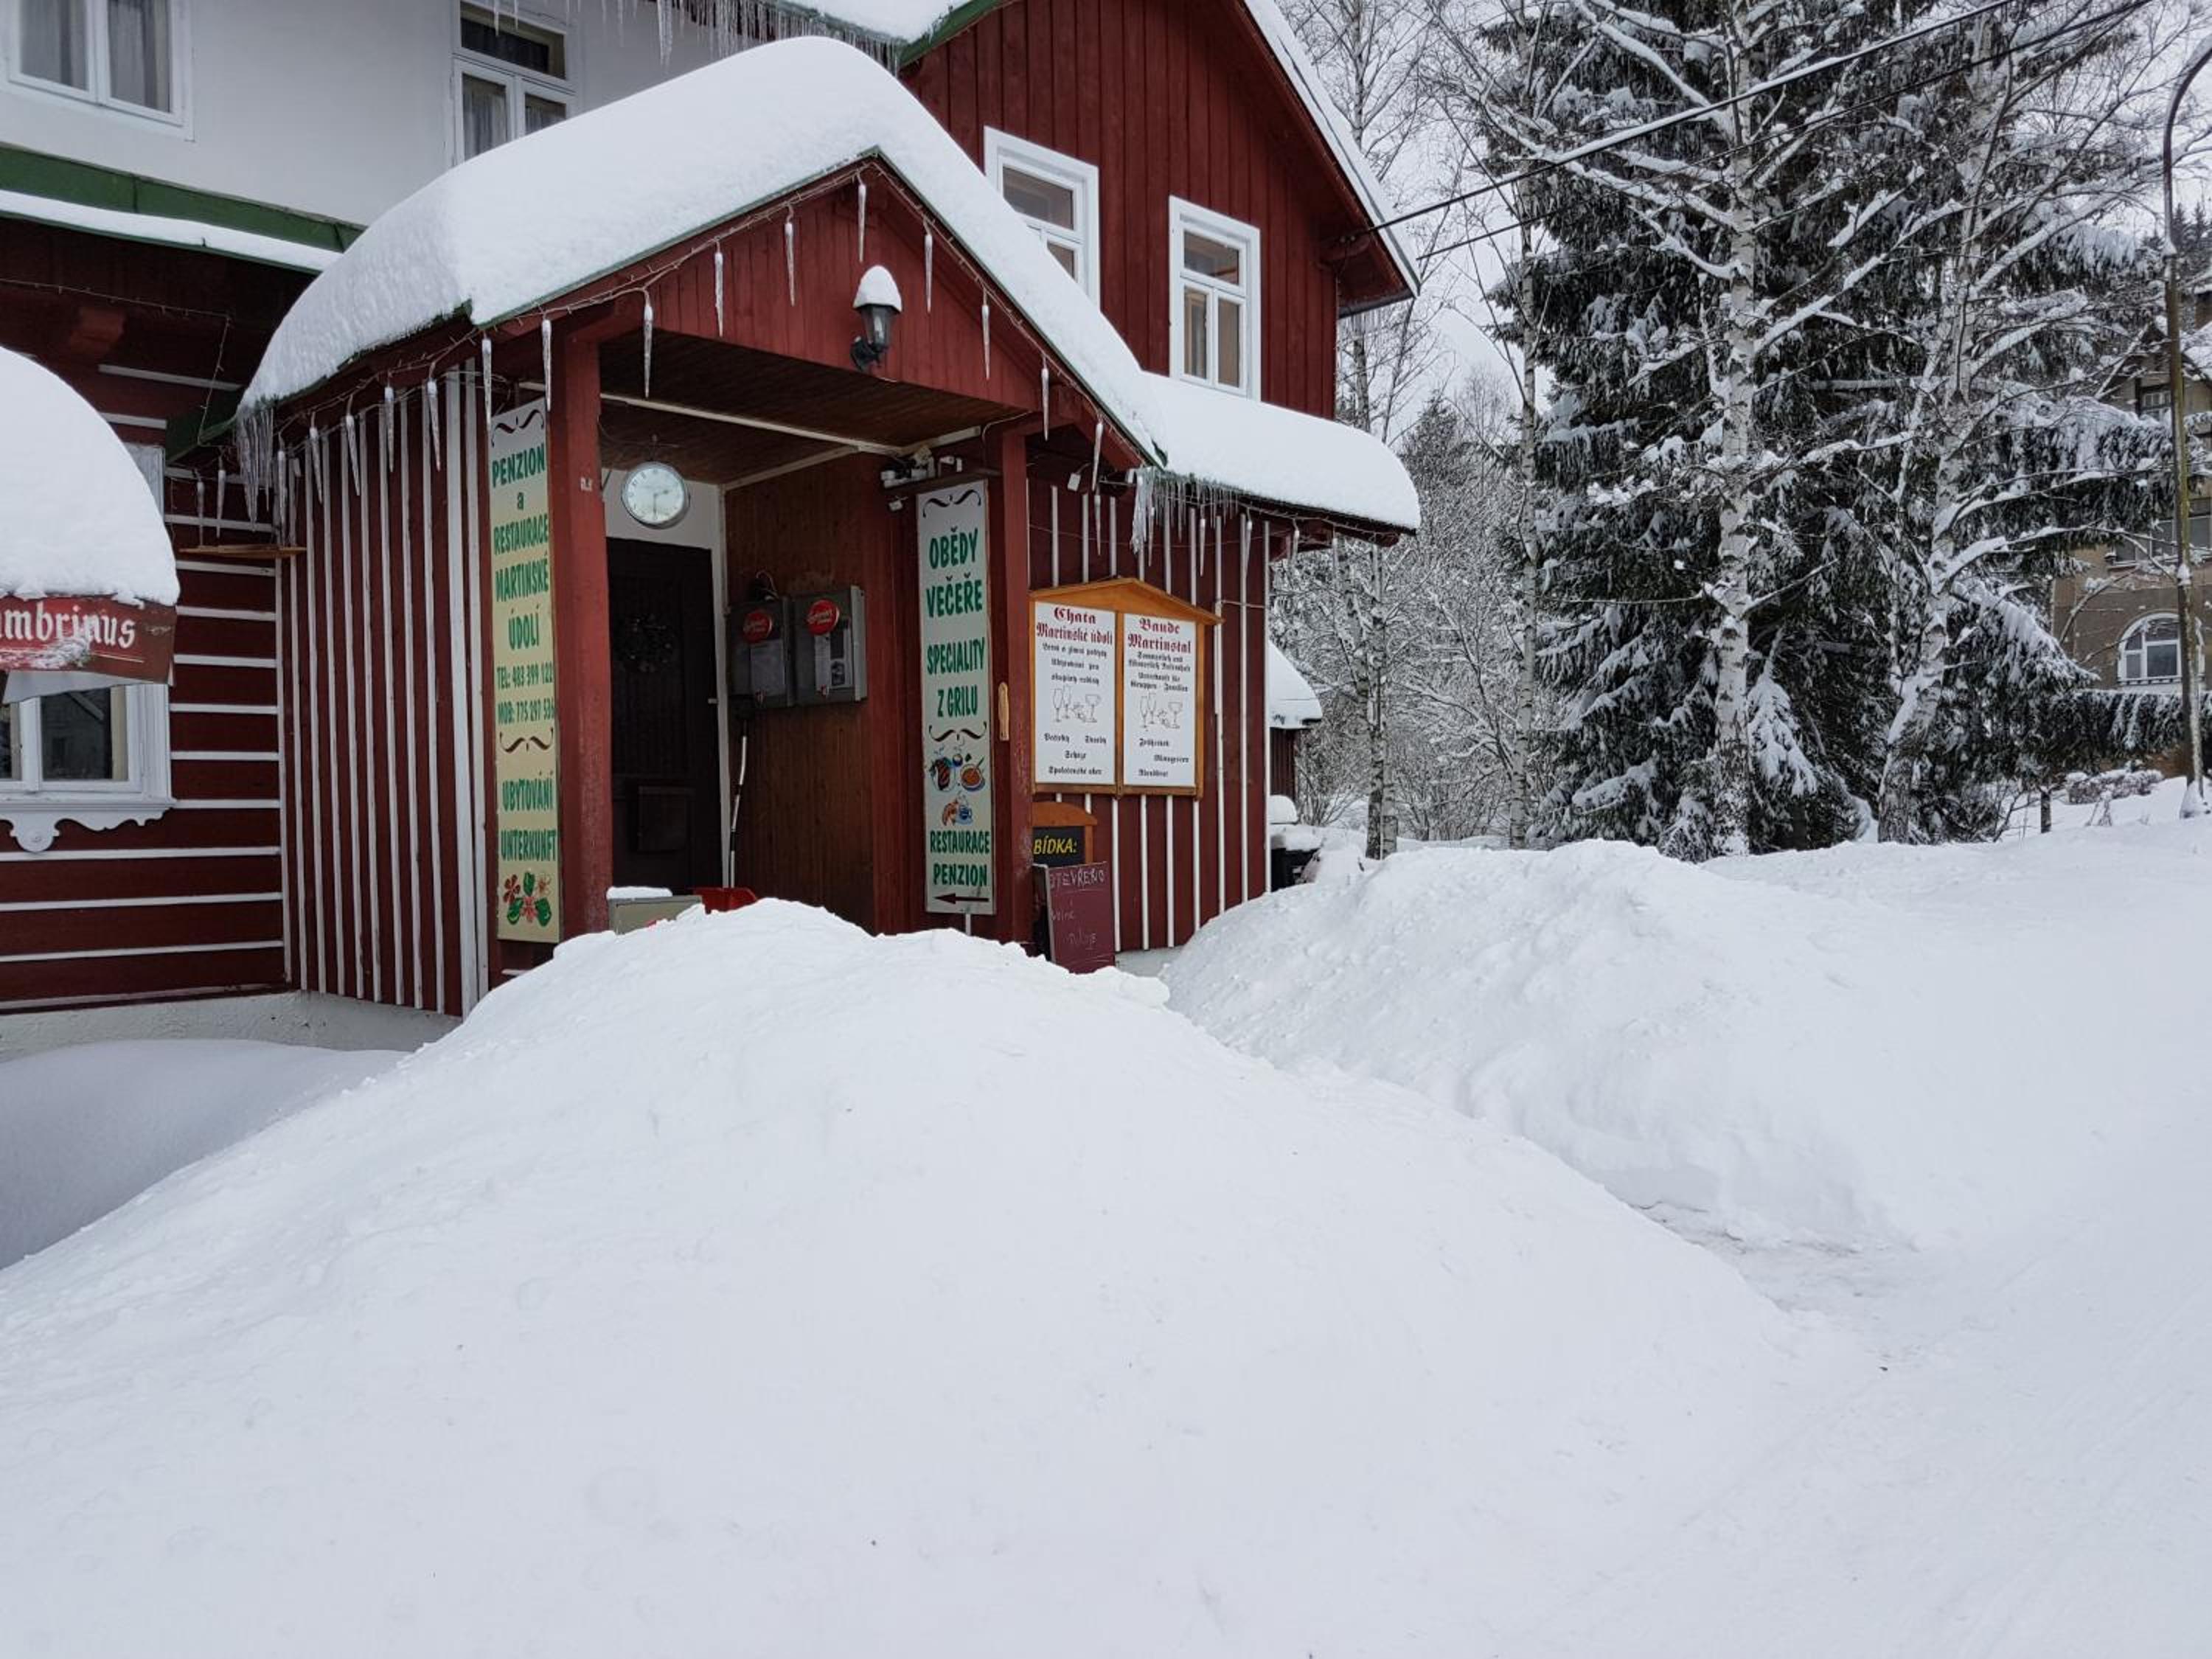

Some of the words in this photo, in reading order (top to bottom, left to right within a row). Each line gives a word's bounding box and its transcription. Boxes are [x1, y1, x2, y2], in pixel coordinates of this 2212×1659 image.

[492, 442, 546, 488] PENZION
[517, 491, 524, 510] a
[493, 513, 548, 555] RESTAURACE
[928, 526, 978, 569] OBĚDY
[495, 551, 549, 602] MARTINSKÉ
[926, 572, 983, 618] VEČEŘE
[0, 602, 136, 649] mbrinus
[508, 604, 540, 650] ÚDOLÍ
[1054, 607, 1096, 624] Chata
[1139, 618, 1180, 634] Baude
[927, 637, 985, 675] SPECIALITY
[1127, 633, 1191, 653] Martinstal
[937, 689, 945, 717] Z
[947, 685, 978, 717] GRILU
[502, 770, 554, 812] UBYTOVÁNÍ
[501, 828, 557, 862] UNTERKUNFT
[930, 830, 990, 854] RESTAURACE
[933, 863, 987, 887] PENZION
